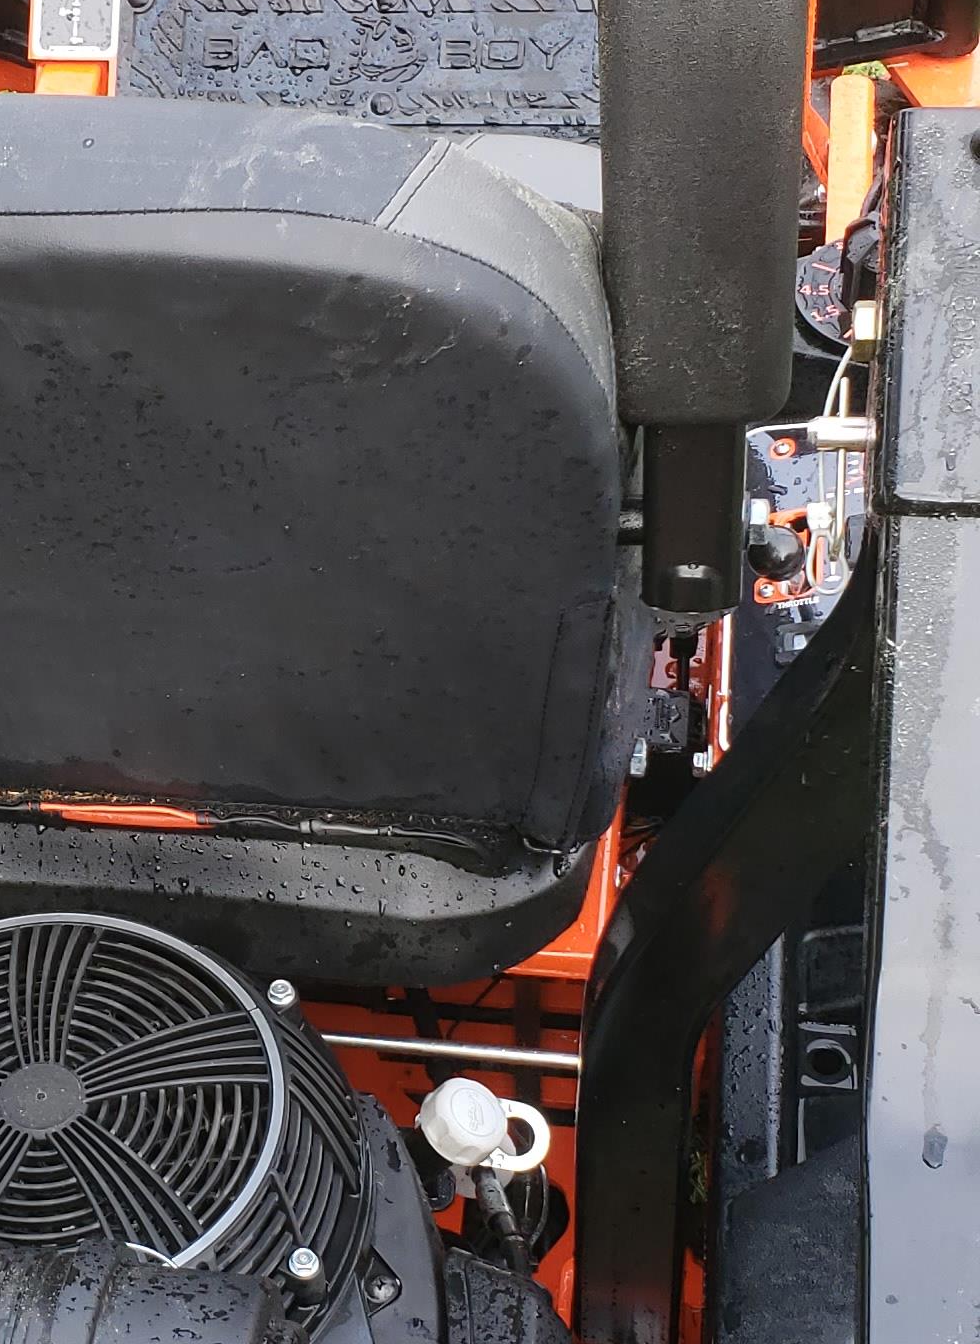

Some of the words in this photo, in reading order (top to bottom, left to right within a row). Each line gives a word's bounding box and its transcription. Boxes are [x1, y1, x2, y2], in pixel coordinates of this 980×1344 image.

[202, 37, 331, 73] BAD
[437, 37, 573, 72] BOY
[799, 284, 830, 296] 4.5
[777, 596, 820, 609] THROTTLE
